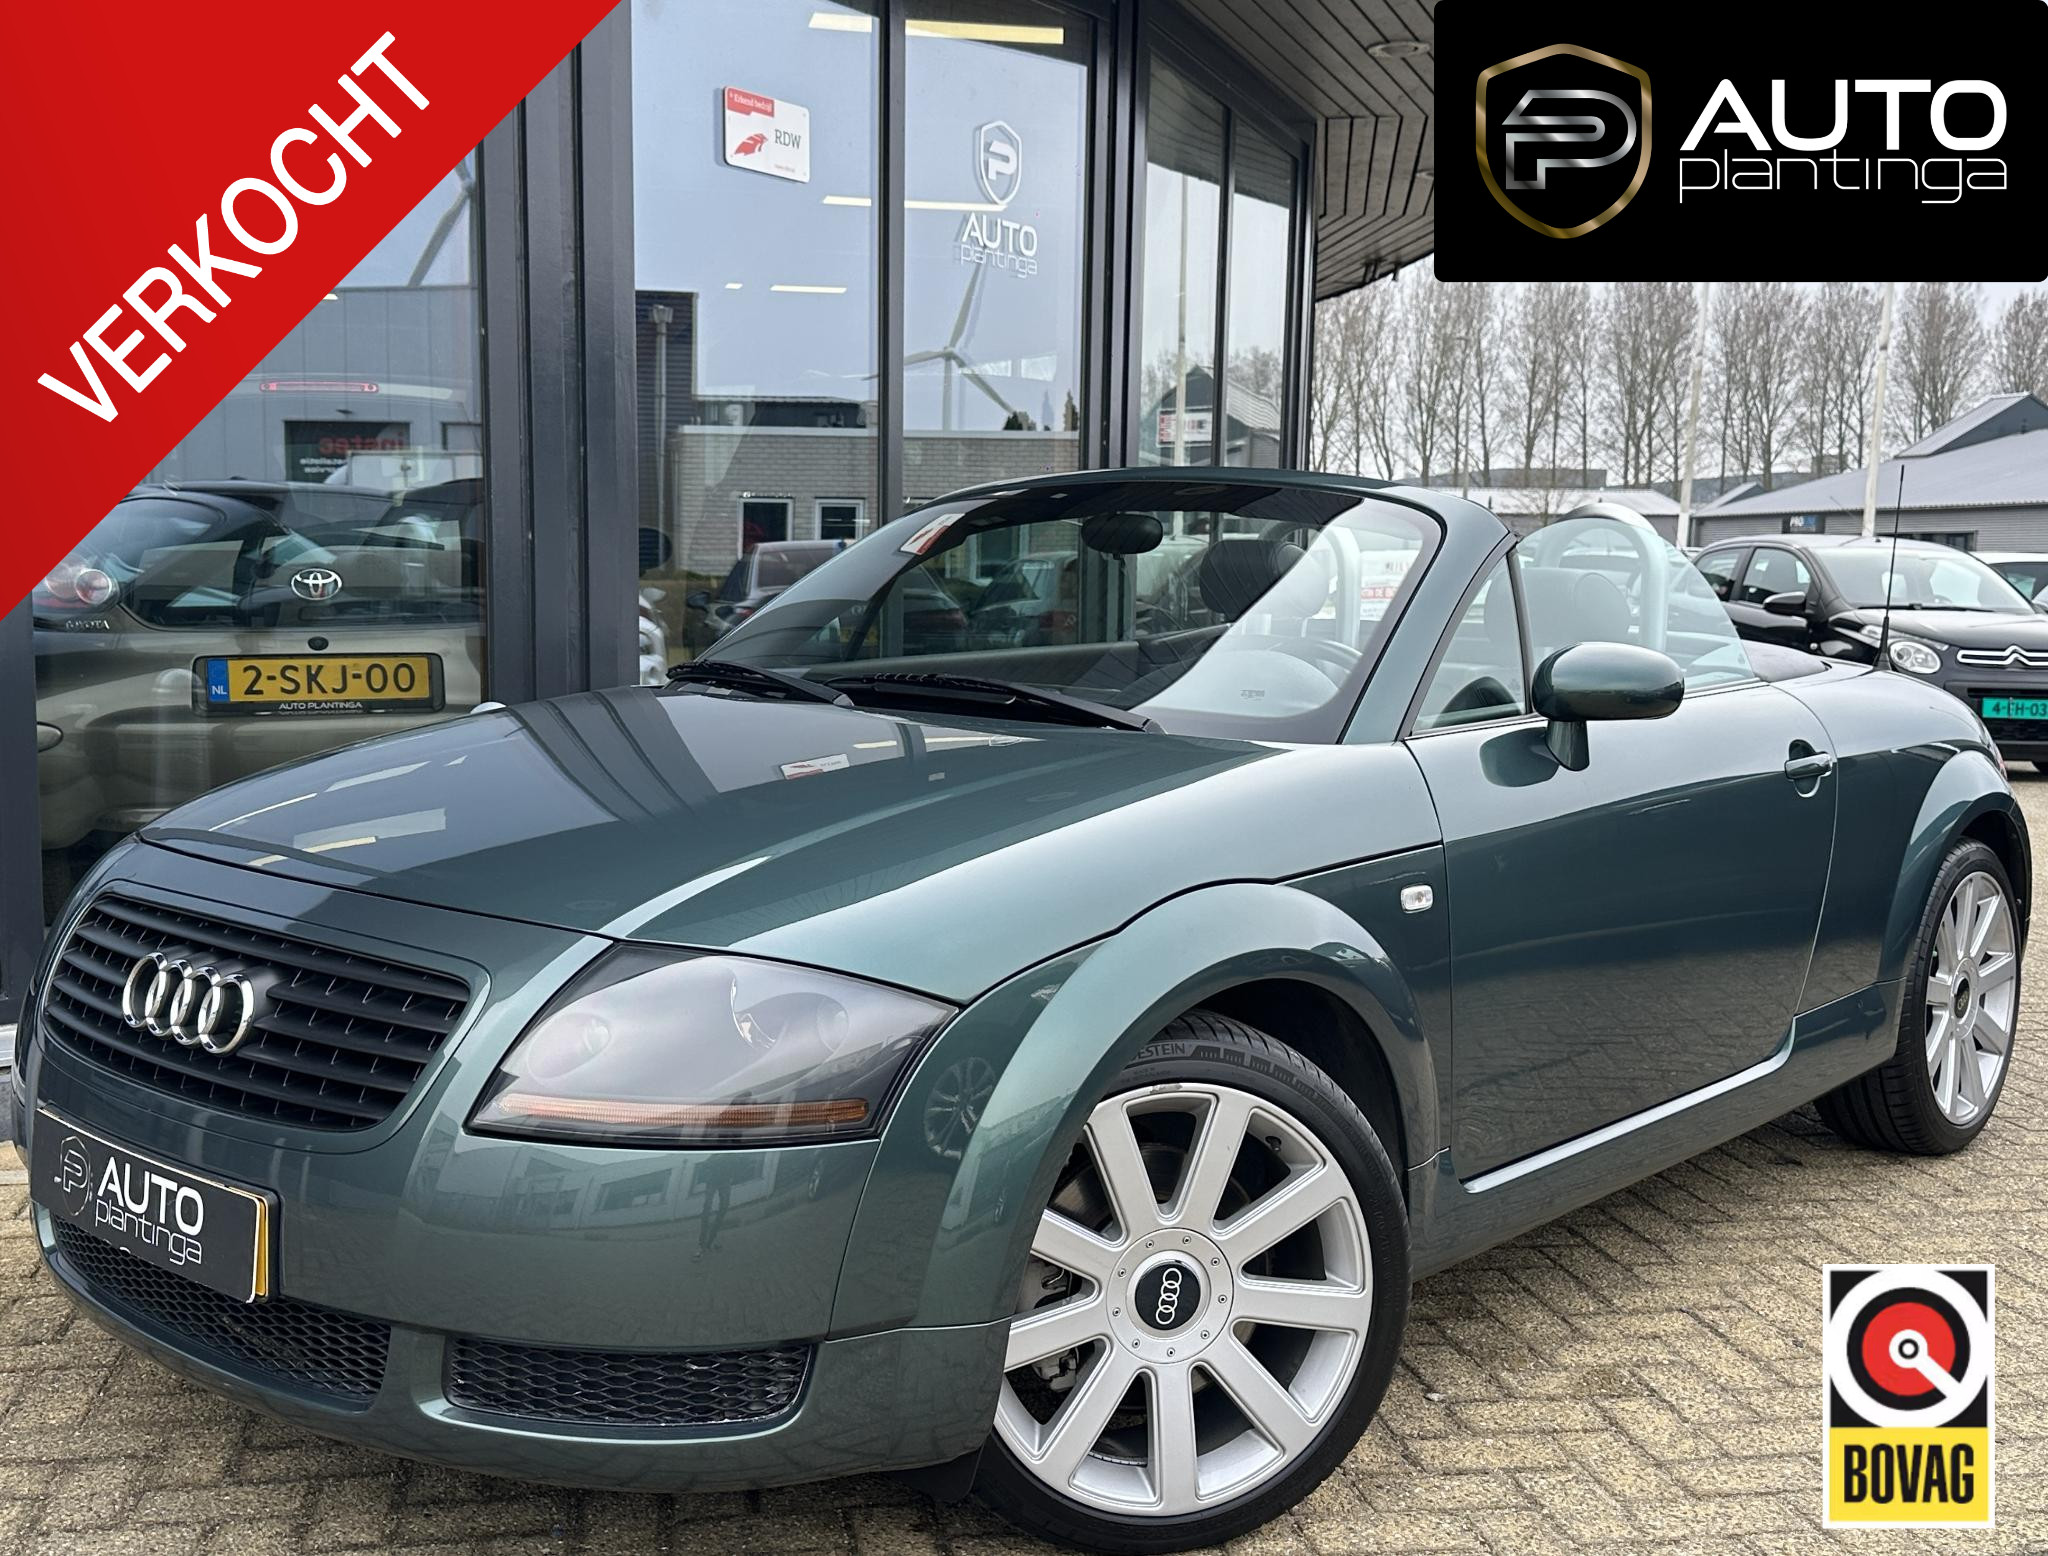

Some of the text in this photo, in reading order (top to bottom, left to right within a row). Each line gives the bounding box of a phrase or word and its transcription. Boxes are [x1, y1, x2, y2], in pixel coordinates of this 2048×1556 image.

[774, 129, 802, 149] RDW
[961, 212, 1038, 257] AUTO
[960, 244, 1038, 279] plantinga
[211, 685, 228, 696] NL
[242, 663, 416, 695] 2-SKJ-00
[278, 701, 363, 710] AUTO PLANTINGA
[1133, 1043, 1185, 1060] ESTEIN
[97, 1157, 204, 1236] AUTO
[95, 1199, 202, 1265] plantinga
